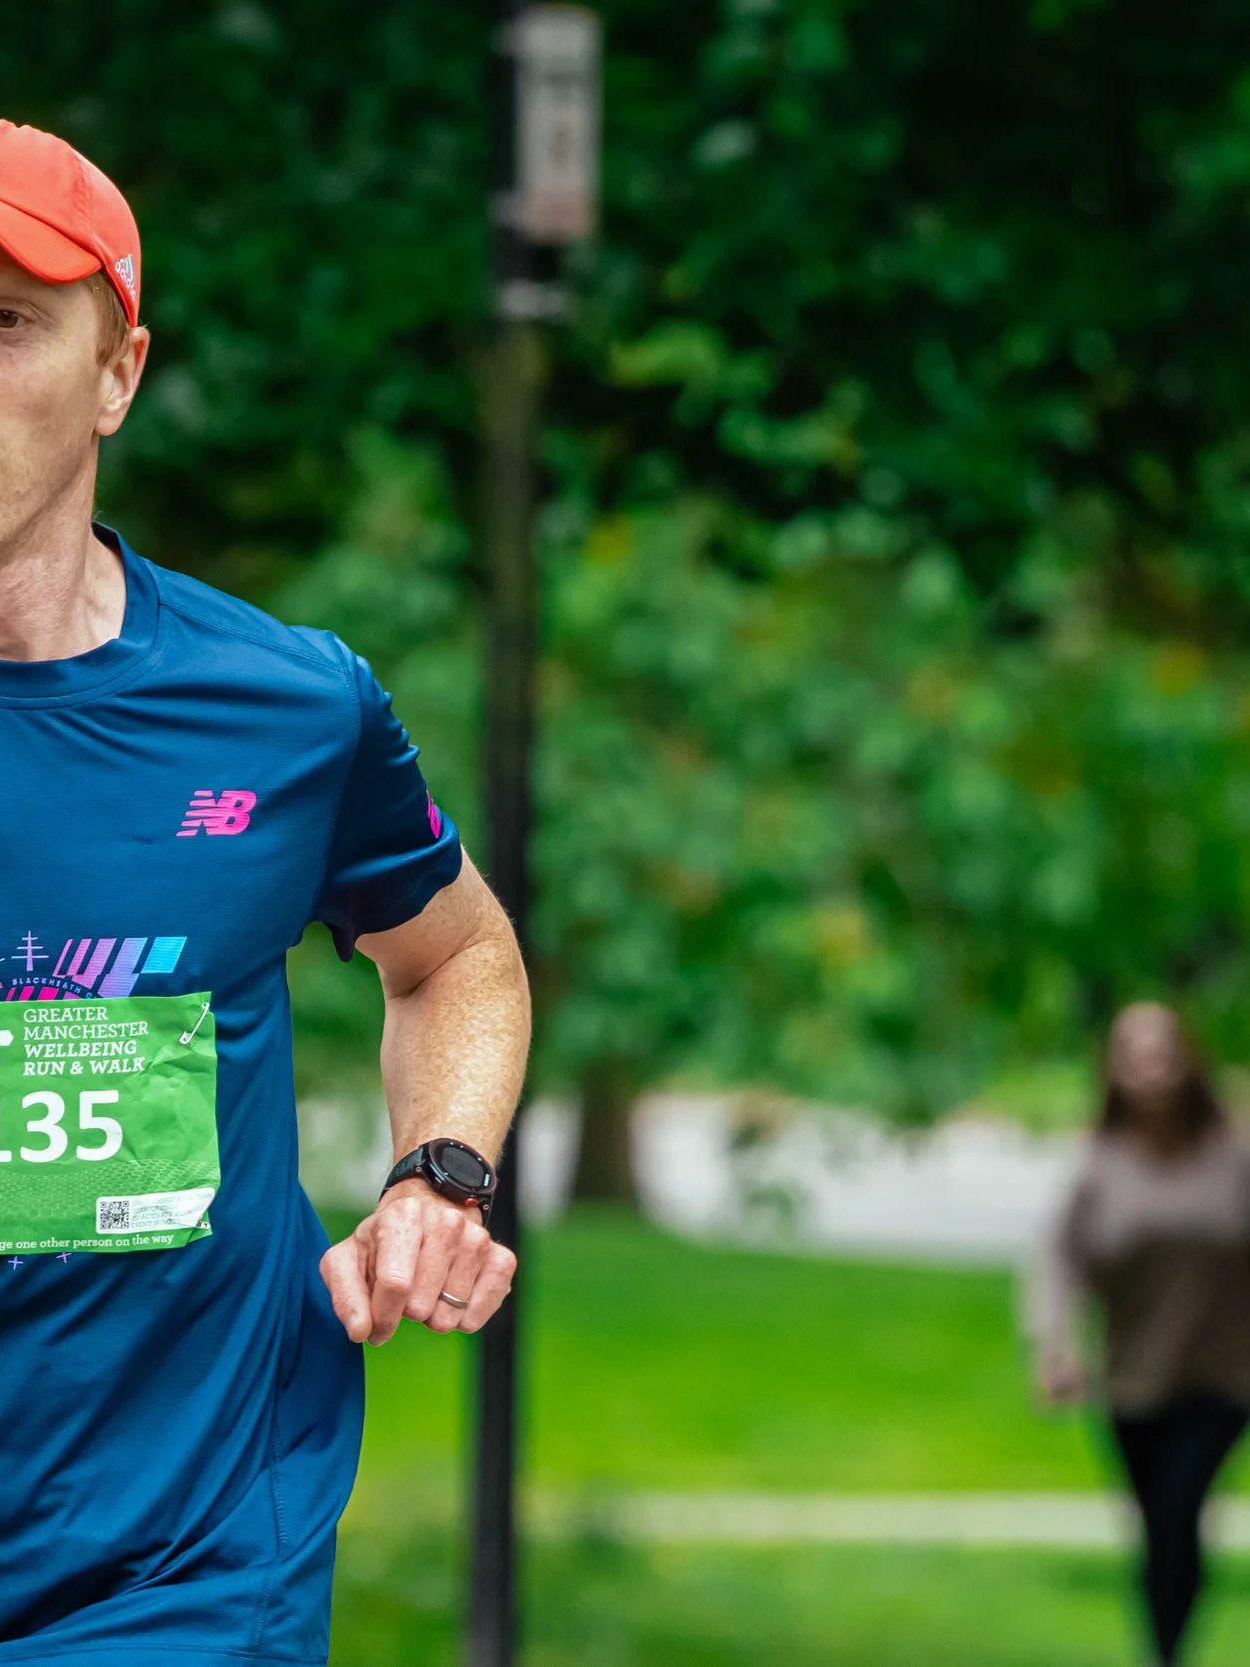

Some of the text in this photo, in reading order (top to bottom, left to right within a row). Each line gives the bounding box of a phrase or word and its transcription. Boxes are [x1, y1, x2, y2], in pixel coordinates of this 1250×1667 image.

[12, 977, 82, 994] BLACKHEATH
[23, 1006, 109, 1023] GREATER
[23, 1020, 149, 1041] MANCHESTER
[23, 1039, 138, 1059] WELLBEING
[22, 1056, 146, 1077] RUN & WALK
[15, 1240, 37, 1249] one
[39, 1236, 70, 1248] other
[72, 1238, 113, 1249] person
[115, 1237, 130, 1247] on
[132, 1233, 149, 1245] the
[151, 1234, 175, 1245] way
